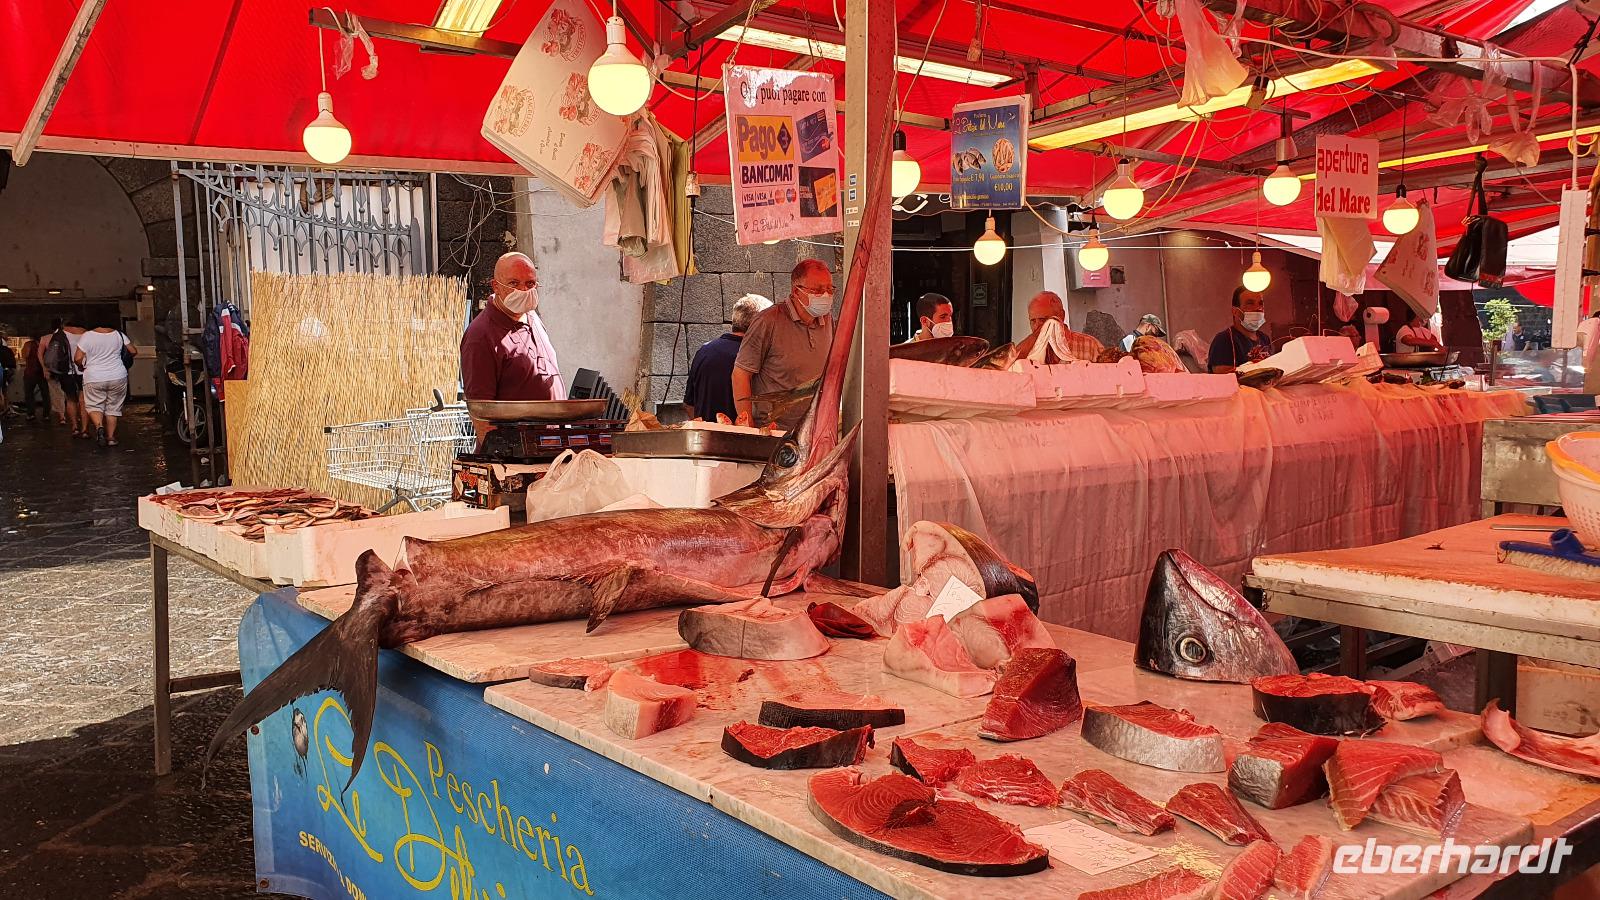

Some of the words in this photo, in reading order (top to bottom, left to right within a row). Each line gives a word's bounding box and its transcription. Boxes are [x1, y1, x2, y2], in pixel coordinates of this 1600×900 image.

[783, 88, 809, 105] pagare
[812, 90, 827, 103] con
[737, 116, 776, 160] Pago
[742, 163, 794, 185] BANCOMAT
[1317, 143, 1369, 179] apertura
[743, 192, 755, 203] VISA
[756, 189, 768, 201] VISA
[1339, 187, 1371, 214] Mare
[424, 740, 595, 896] Pescheria
